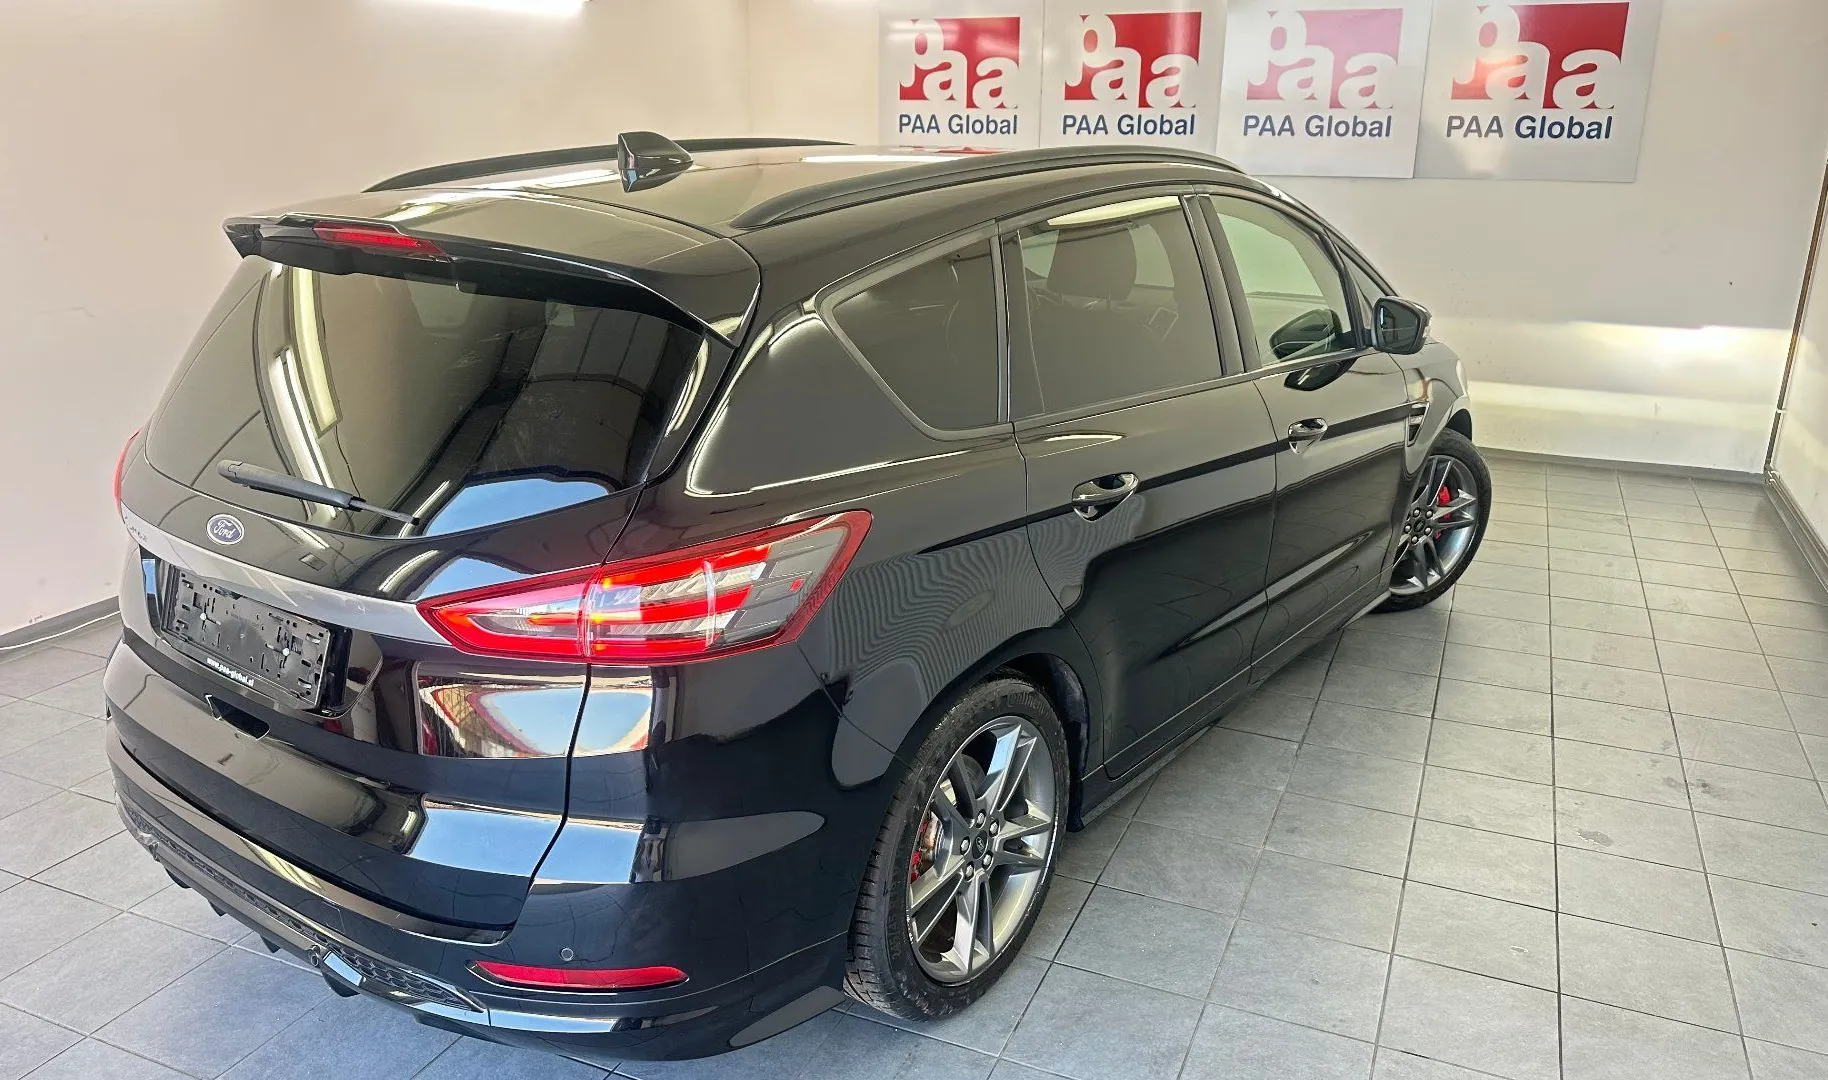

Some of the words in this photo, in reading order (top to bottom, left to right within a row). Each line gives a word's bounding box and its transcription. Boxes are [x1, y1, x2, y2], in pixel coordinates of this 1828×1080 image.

[898, 113, 941, 135] PAA
[948, 113, 1018, 136] Global
[1062, 113, 1109, 136] PAA
[1117, 113, 1196, 136] Global
[1243, 114, 1296, 137] PAA
[1305, 114, 1392, 138] Global
[1445, 115, 1504, 139] PAA
[1514, 115, 1613, 140] Global
